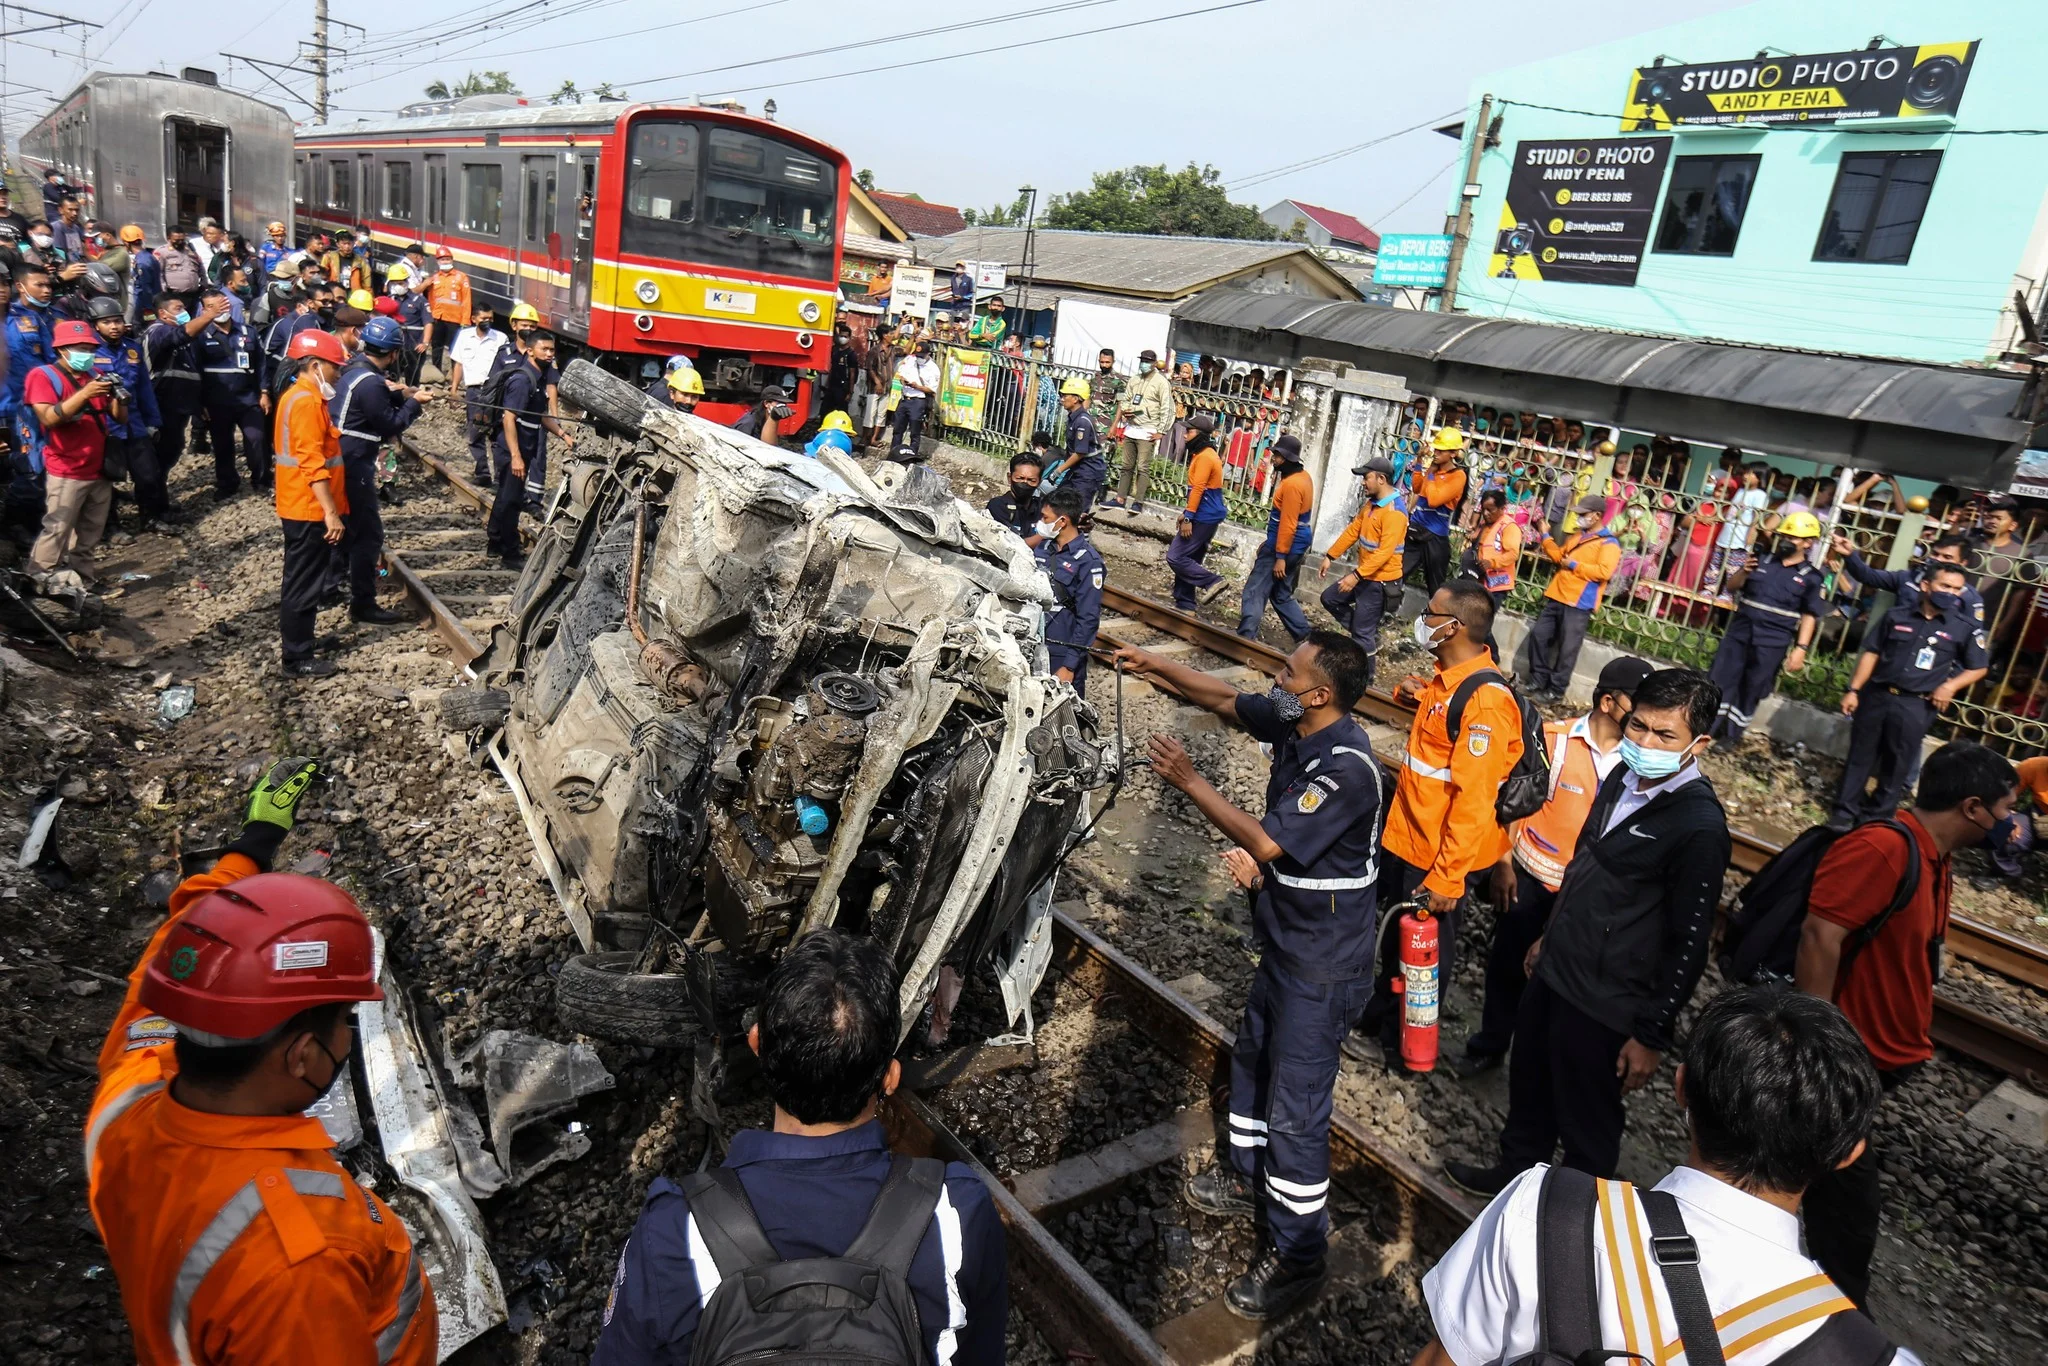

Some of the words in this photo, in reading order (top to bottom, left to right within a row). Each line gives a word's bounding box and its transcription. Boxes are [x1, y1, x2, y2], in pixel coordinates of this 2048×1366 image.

[1680, 65, 1782, 92] STUDIO
[1791, 57, 1899, 86] PHOTO
[1720, 93, 1772, 110] ANDY
[1778, 90, 1831, 107] PENA
[1808, 110, 1880, 121] www.andypena.com
[1526, 147, 1591, 165] STUDIO
[1595, 146, 1655, 164] PHOTO
[1542, 168, 1583, 181] ANDY
[1585, 168, 1625, 180] PENA
[1564, 221, 1624, 233] @andypena321
[1399, 239, 1427, 256] DEPOK
[1428, 239, 1452, 257] BERS
[1558, 251, 1637, 263] www.andypena.com
